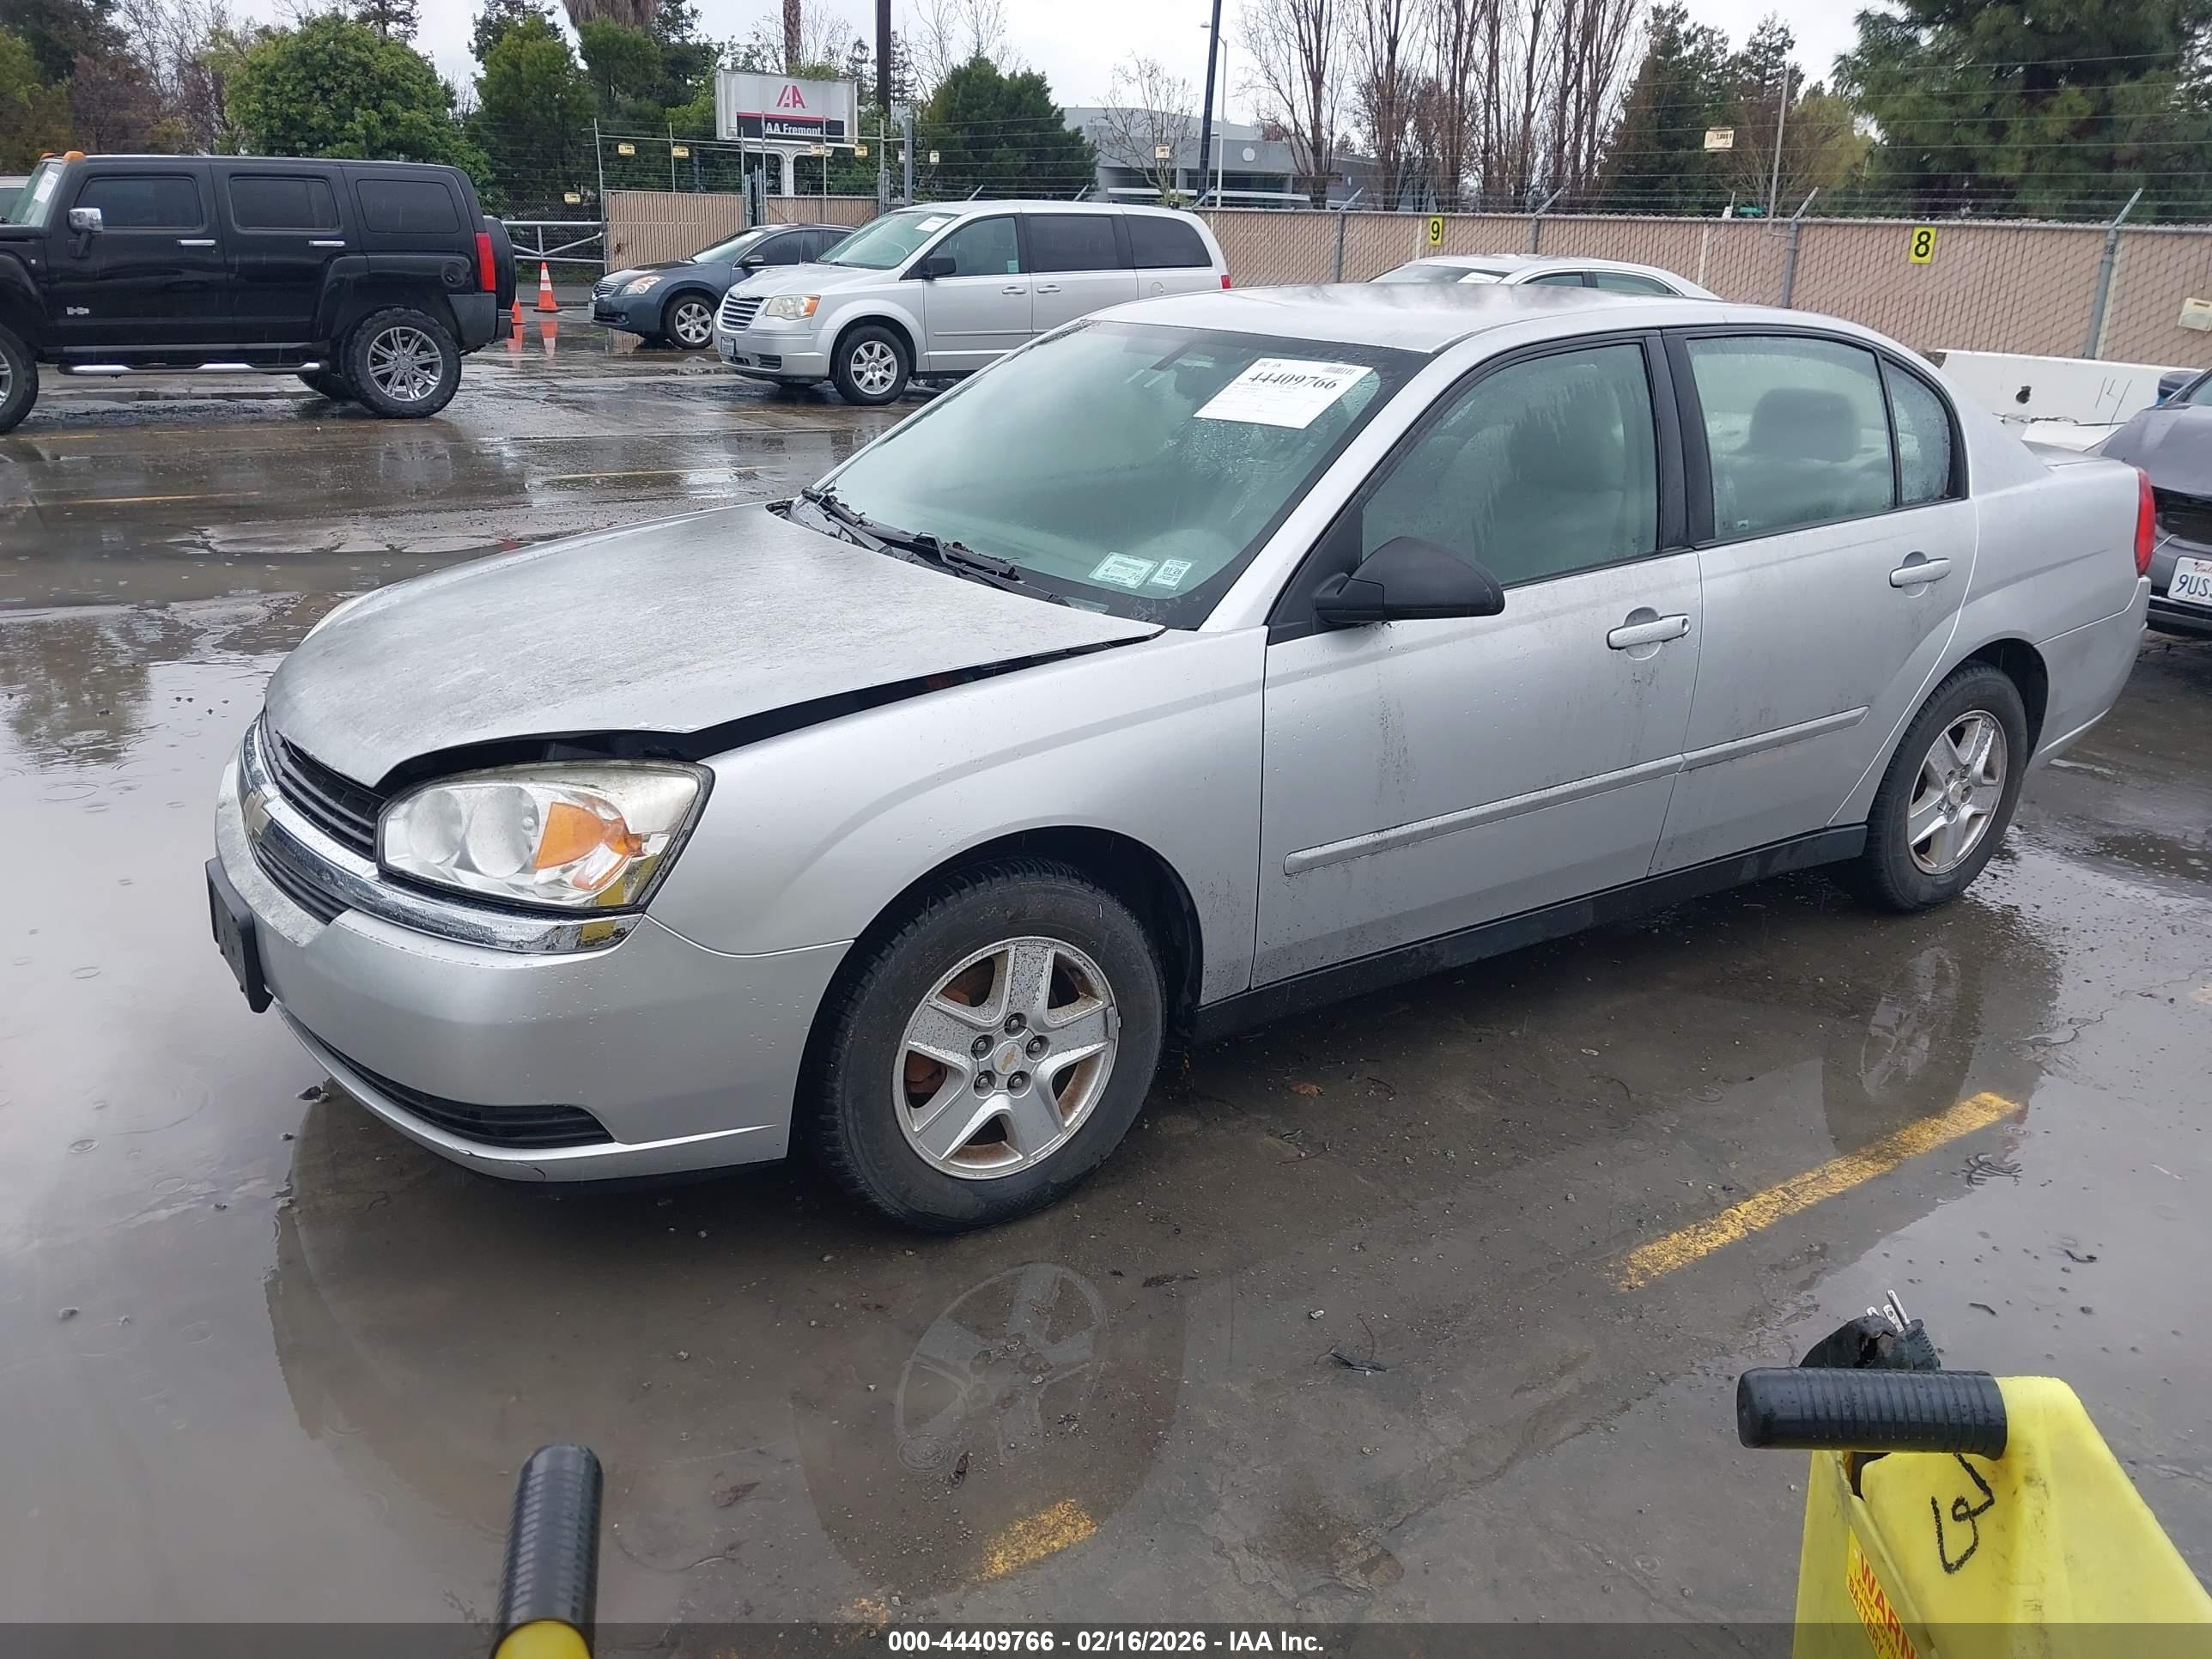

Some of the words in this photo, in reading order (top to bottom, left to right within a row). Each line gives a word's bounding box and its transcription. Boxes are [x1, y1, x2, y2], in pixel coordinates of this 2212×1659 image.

[783, 123, 822, 137] Fremont
[1431, 221, 1440, 241] 9
[1914, 231, 1931, 258] 8
[2174, 574, 2212, 599] 9US
[1847, 1573, 1884, 1656] BATTERY
